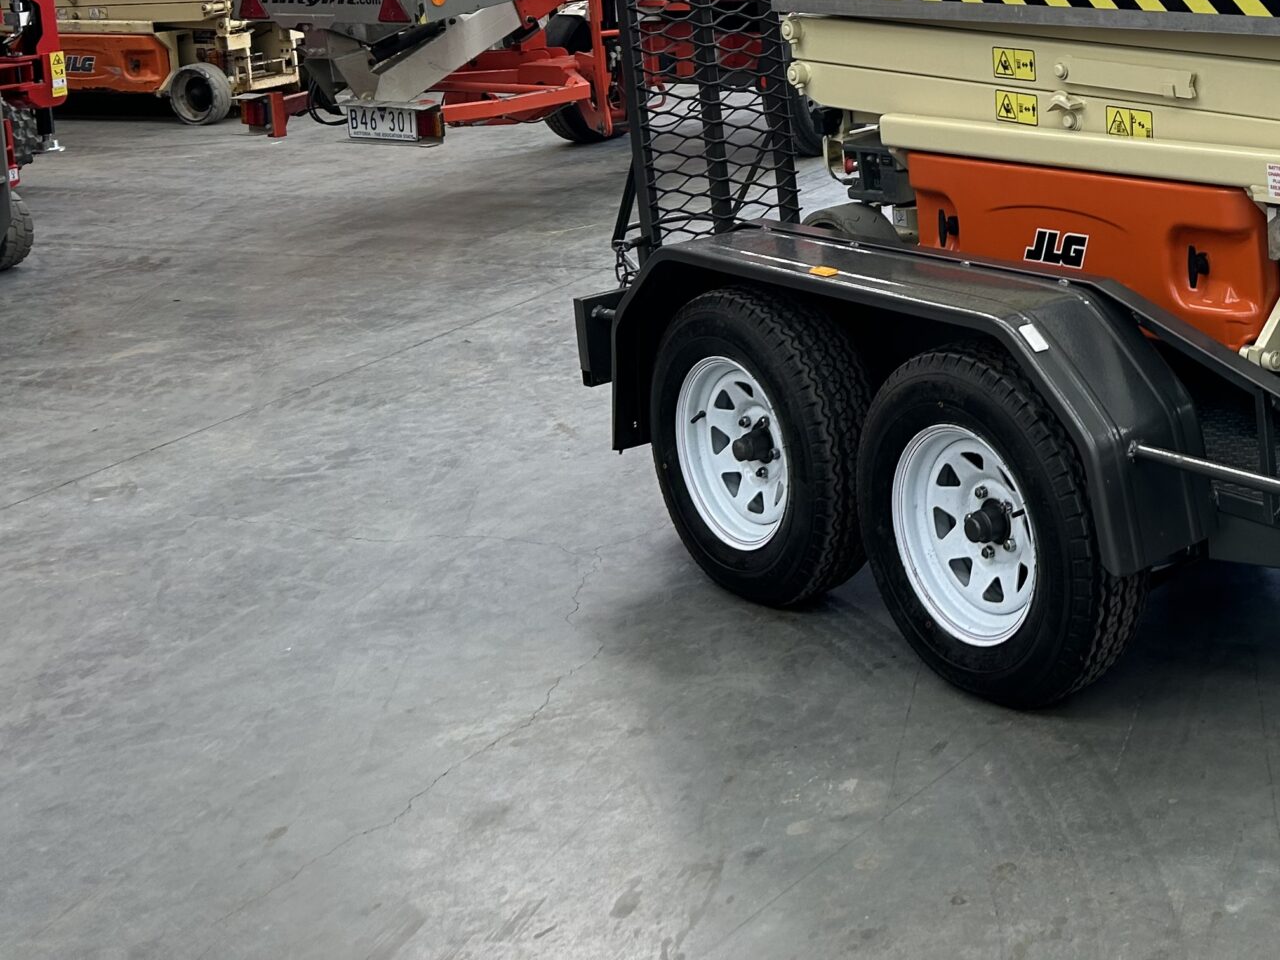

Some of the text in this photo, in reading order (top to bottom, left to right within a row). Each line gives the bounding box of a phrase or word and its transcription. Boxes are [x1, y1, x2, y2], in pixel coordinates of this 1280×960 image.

[350, 109, 413, 133] B46 301
[1024, 228, 1089, 269] JLG
